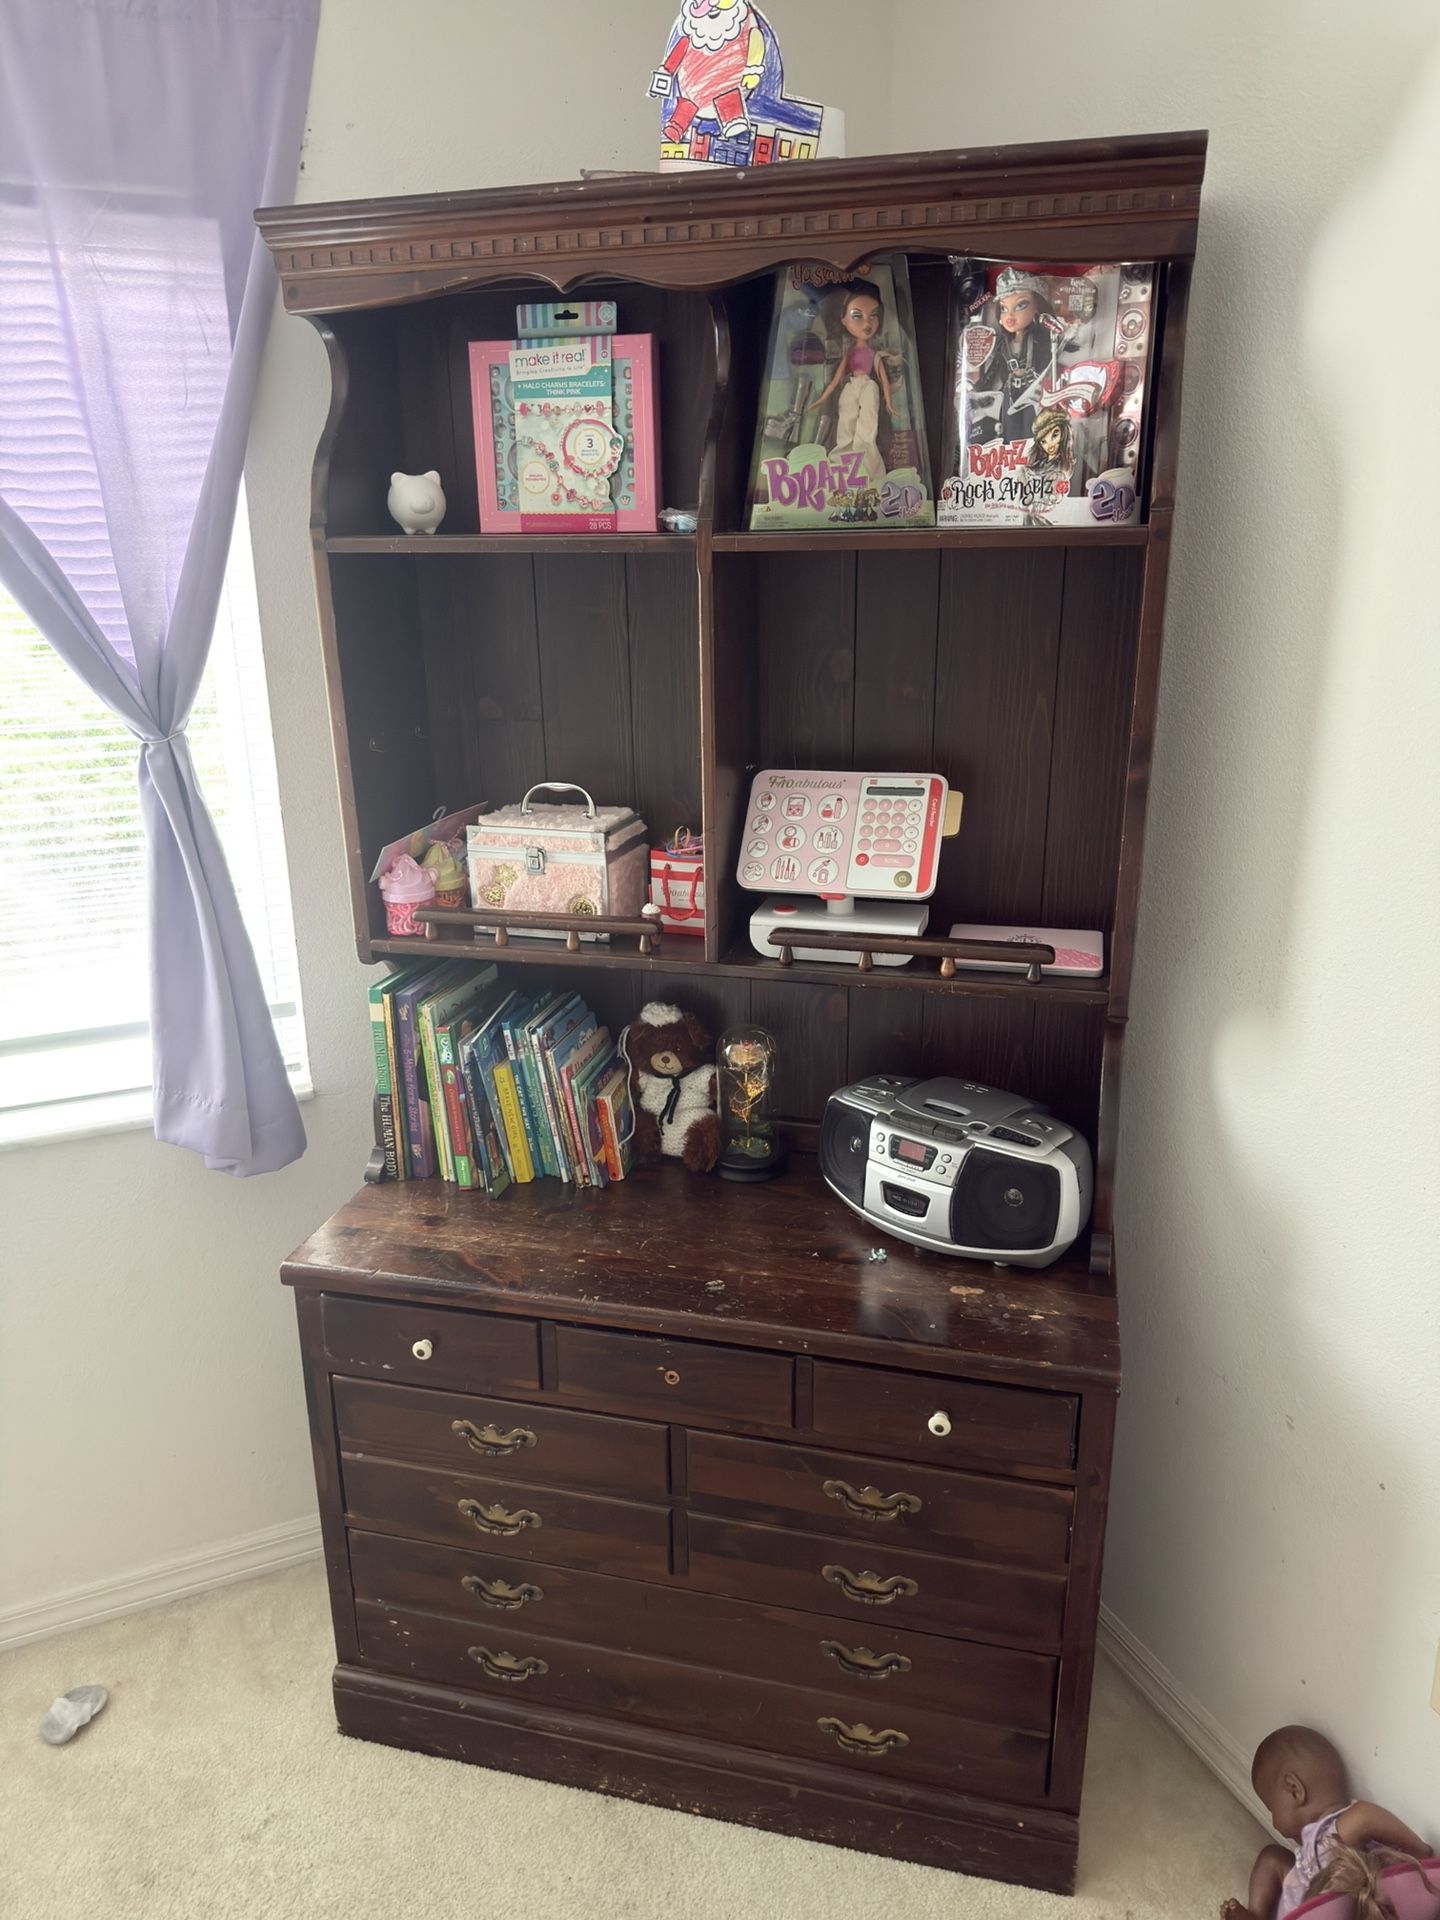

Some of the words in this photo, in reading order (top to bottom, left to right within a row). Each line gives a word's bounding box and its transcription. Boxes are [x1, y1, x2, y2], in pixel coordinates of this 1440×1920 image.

[515, 353, 550, 368] make
[552, 351, 559, 364] it
[561, 349, 585, 363] real
[586, 438, 594, 448] 3
[968, 441, 1028, 478] BRATZ
[766, 452, 866, 511] BRATZ
[880, 481, 923, 517] 20
[1090, 480, 1136, 520] 20
[598, 521, 612, 529] PCS
[374, 1029, 383, 1047] Tell
[375, 1047, 384, 1064] Me
[377, 1066, 388, 1090] About
[402, 1049, 415, 1082] 5-Minute
[409, 1106, 419, 1132] Stories
[503, 1088, 511, 1107] BRAVE
[379, 1096, 390, 1113] The
[507, 1107, 516, 1125] NEW
[523, 1118, 531, 1130] HAT
[381, 1114, 395, 1152] HUMAN
[511, 1125, 519, 1140] GIRL
[385, 1152, 398, 1178] BODY
